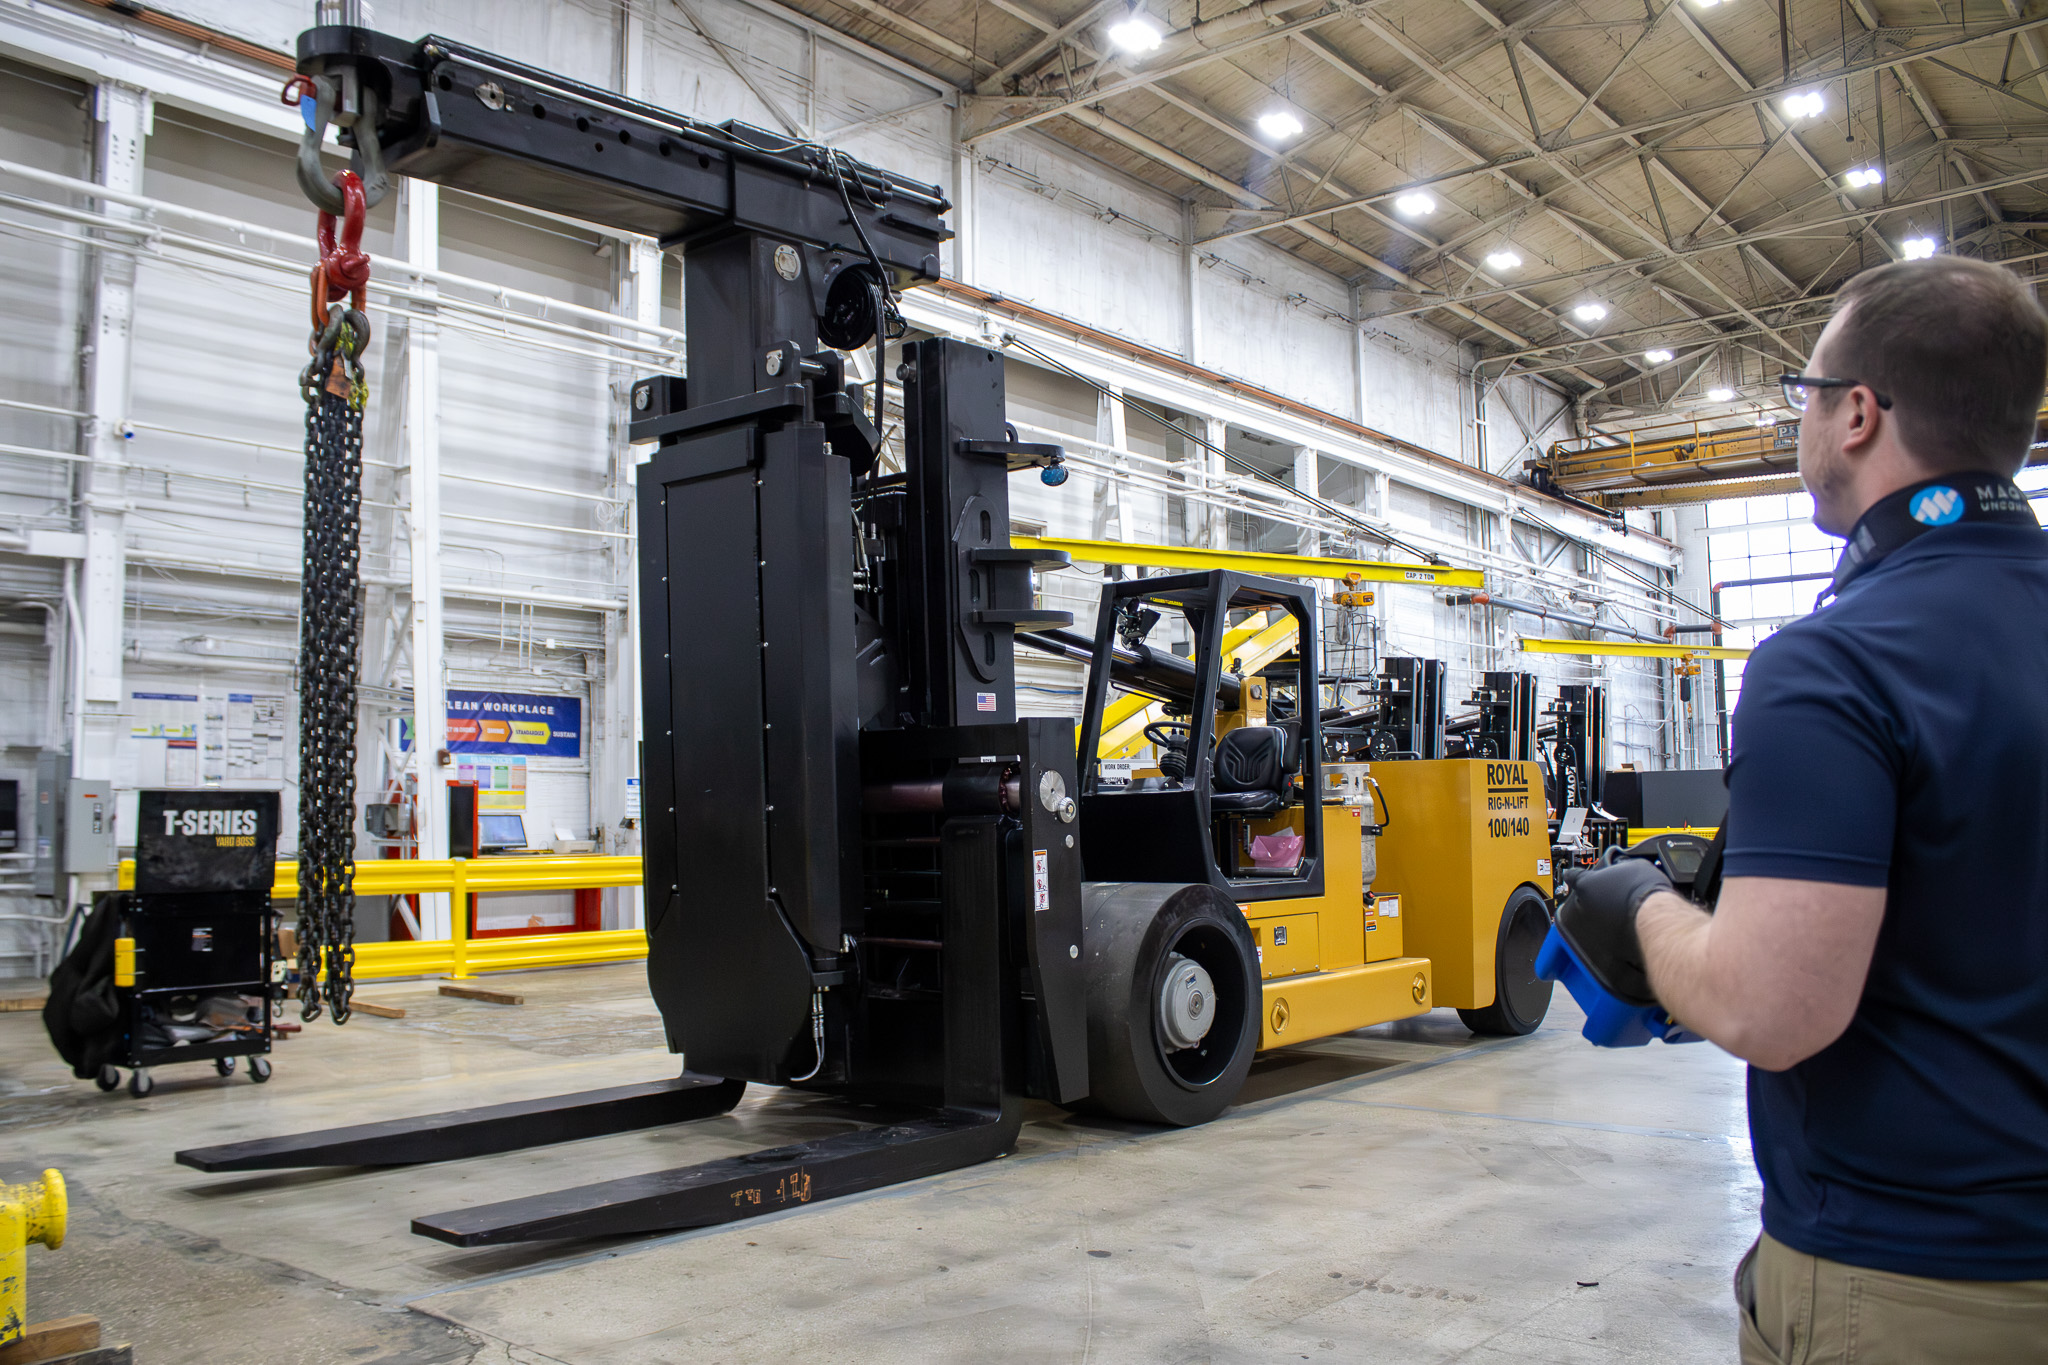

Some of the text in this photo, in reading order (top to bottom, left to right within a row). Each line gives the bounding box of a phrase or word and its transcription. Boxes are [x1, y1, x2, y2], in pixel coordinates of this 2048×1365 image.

[1424, 573, 1435, 581] TON
[483, 702, 554, 715] WORKPLACE
[1487, 763, 1528, 785] ROYAL
[1488, 796, 1529, 810] RIG-N-LIFT
[163, 810, 257, 836] T-SERIES
[1488, 816, 1530, 838] 100/140
[215, 836, 255, 847] YARD BOSS
